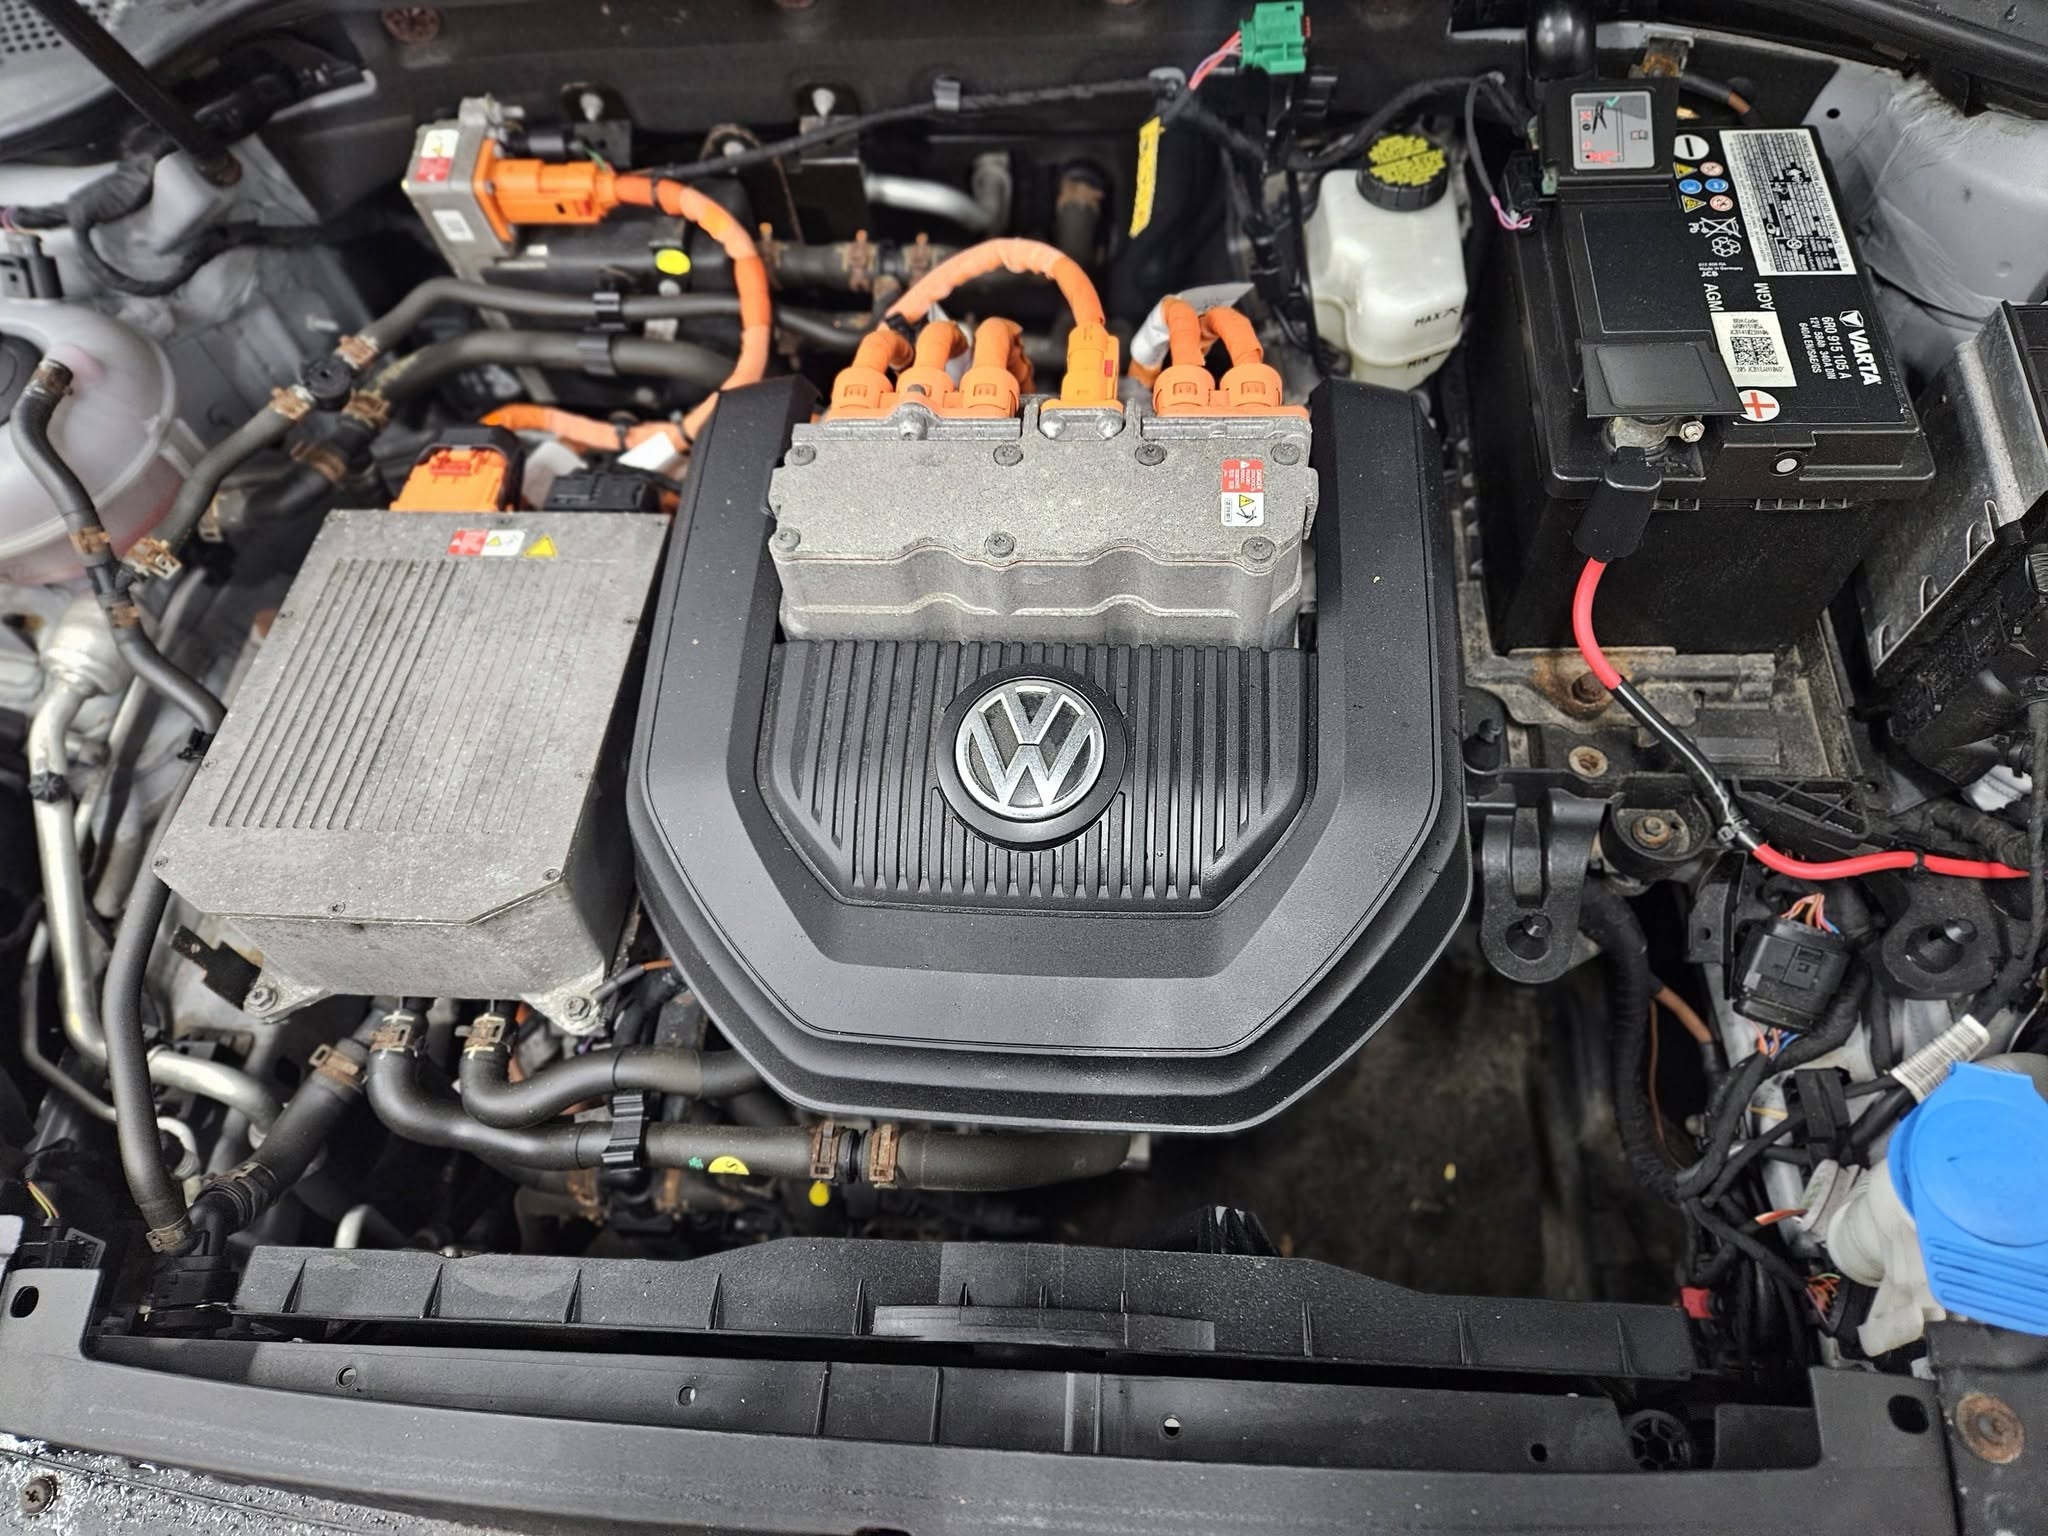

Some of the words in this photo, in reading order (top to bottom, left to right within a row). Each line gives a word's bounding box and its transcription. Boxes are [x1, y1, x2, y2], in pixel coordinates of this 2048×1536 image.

[1703, 283, 1725, 311] AGM
[1754, 282, 1776, 310] AGM
[1414, 312, 1440, 328] MAX
[1809, 316, 1821, 329] 12V
[1821, 316, 1838, 334] 6R0
[1799, 322, 1812, 339] 640A
[1827, 335, 1843, 352] 915
[1803, 339, 1822, 373] EN/SAE/GS
[1820, 350, 1833, 367] 340A
[1833, 354, 1850, 370] 105
[1847, 329, 1881, 386] VARTA
[1825, 368, 1837, 380] DIN
[960, 679, 1101, 814] VW
